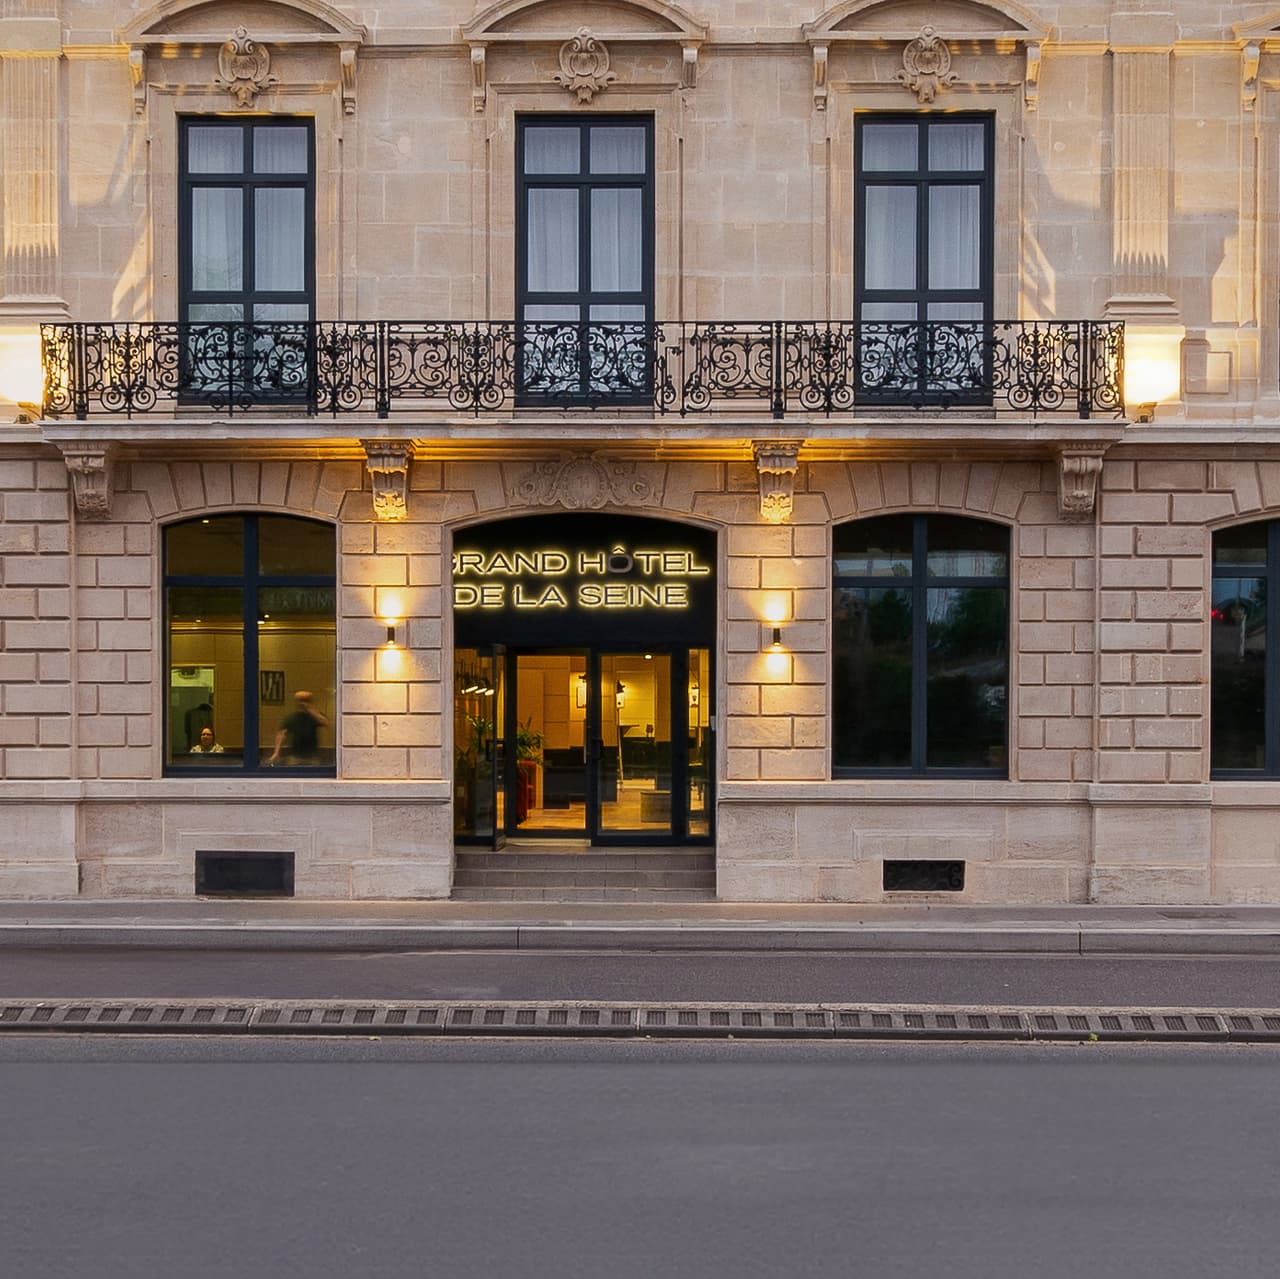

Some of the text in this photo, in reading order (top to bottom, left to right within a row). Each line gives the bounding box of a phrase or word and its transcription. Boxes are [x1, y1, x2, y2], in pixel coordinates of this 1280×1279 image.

[578, 546, 709, 574] HÔTEL
[453, 585, 688, 607] DE LA SEINE
